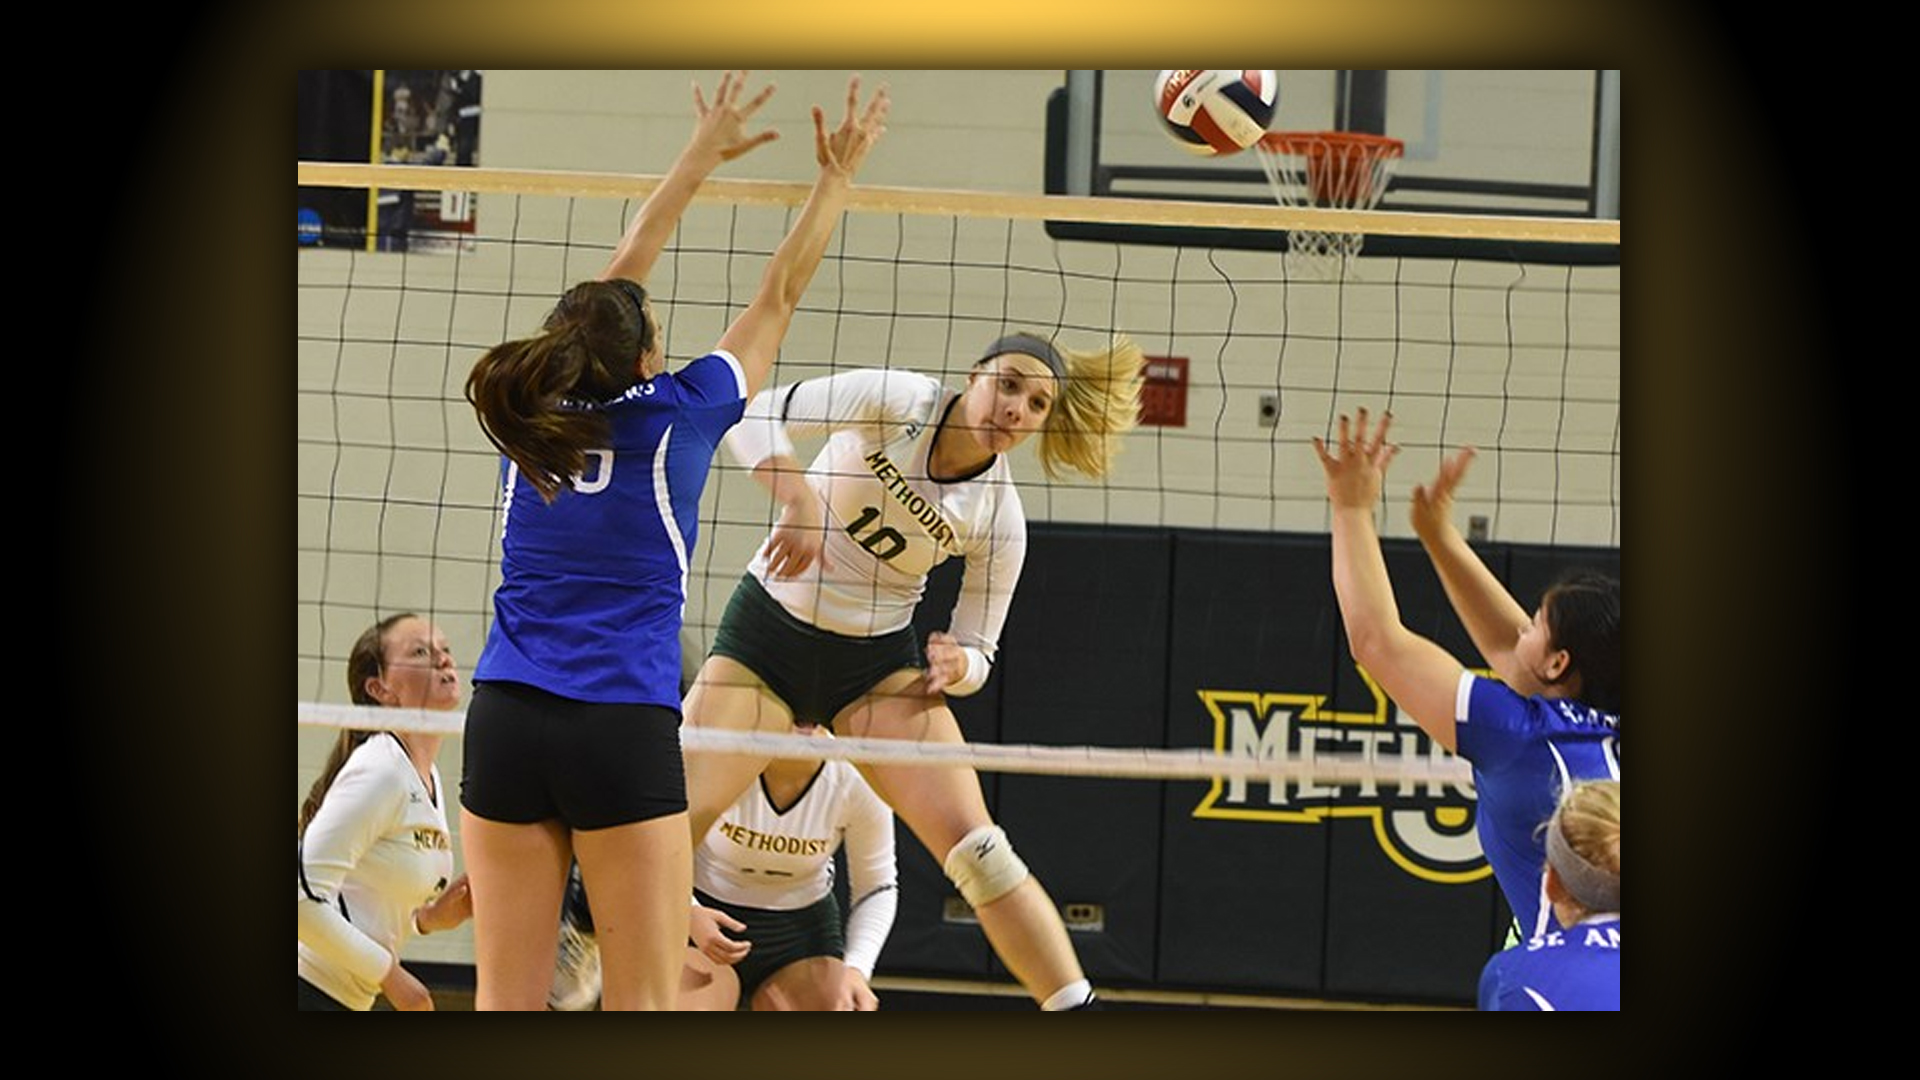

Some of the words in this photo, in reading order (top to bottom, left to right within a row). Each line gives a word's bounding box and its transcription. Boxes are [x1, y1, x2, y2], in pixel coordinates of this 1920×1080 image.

[864, 451, 955, 548] METHODIST
[846, 506, 907, 561] 10
[719, 822, 828, 856] METHODIST
